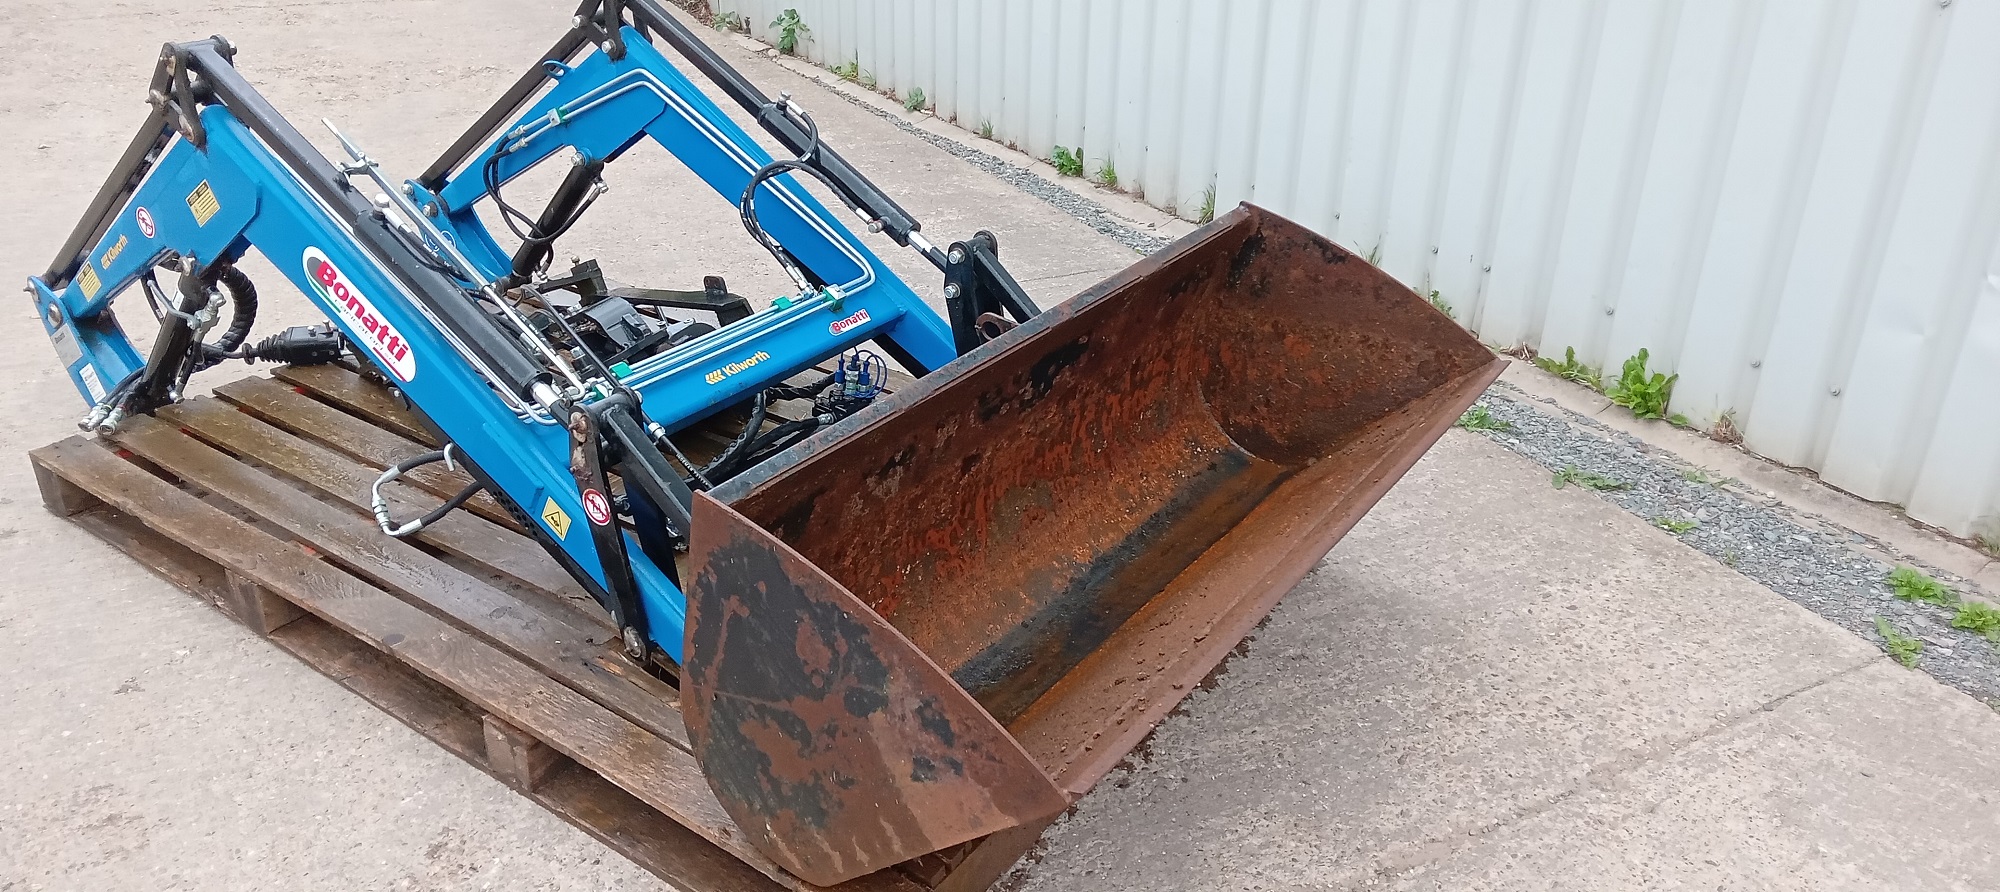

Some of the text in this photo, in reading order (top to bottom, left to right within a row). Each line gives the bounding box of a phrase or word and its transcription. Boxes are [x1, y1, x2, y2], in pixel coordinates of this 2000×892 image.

[316, 260, 409, 362] Bonatti
[832, 309, 869, 333] Bonatti
[722, 350, 770, 377] Kilworth
